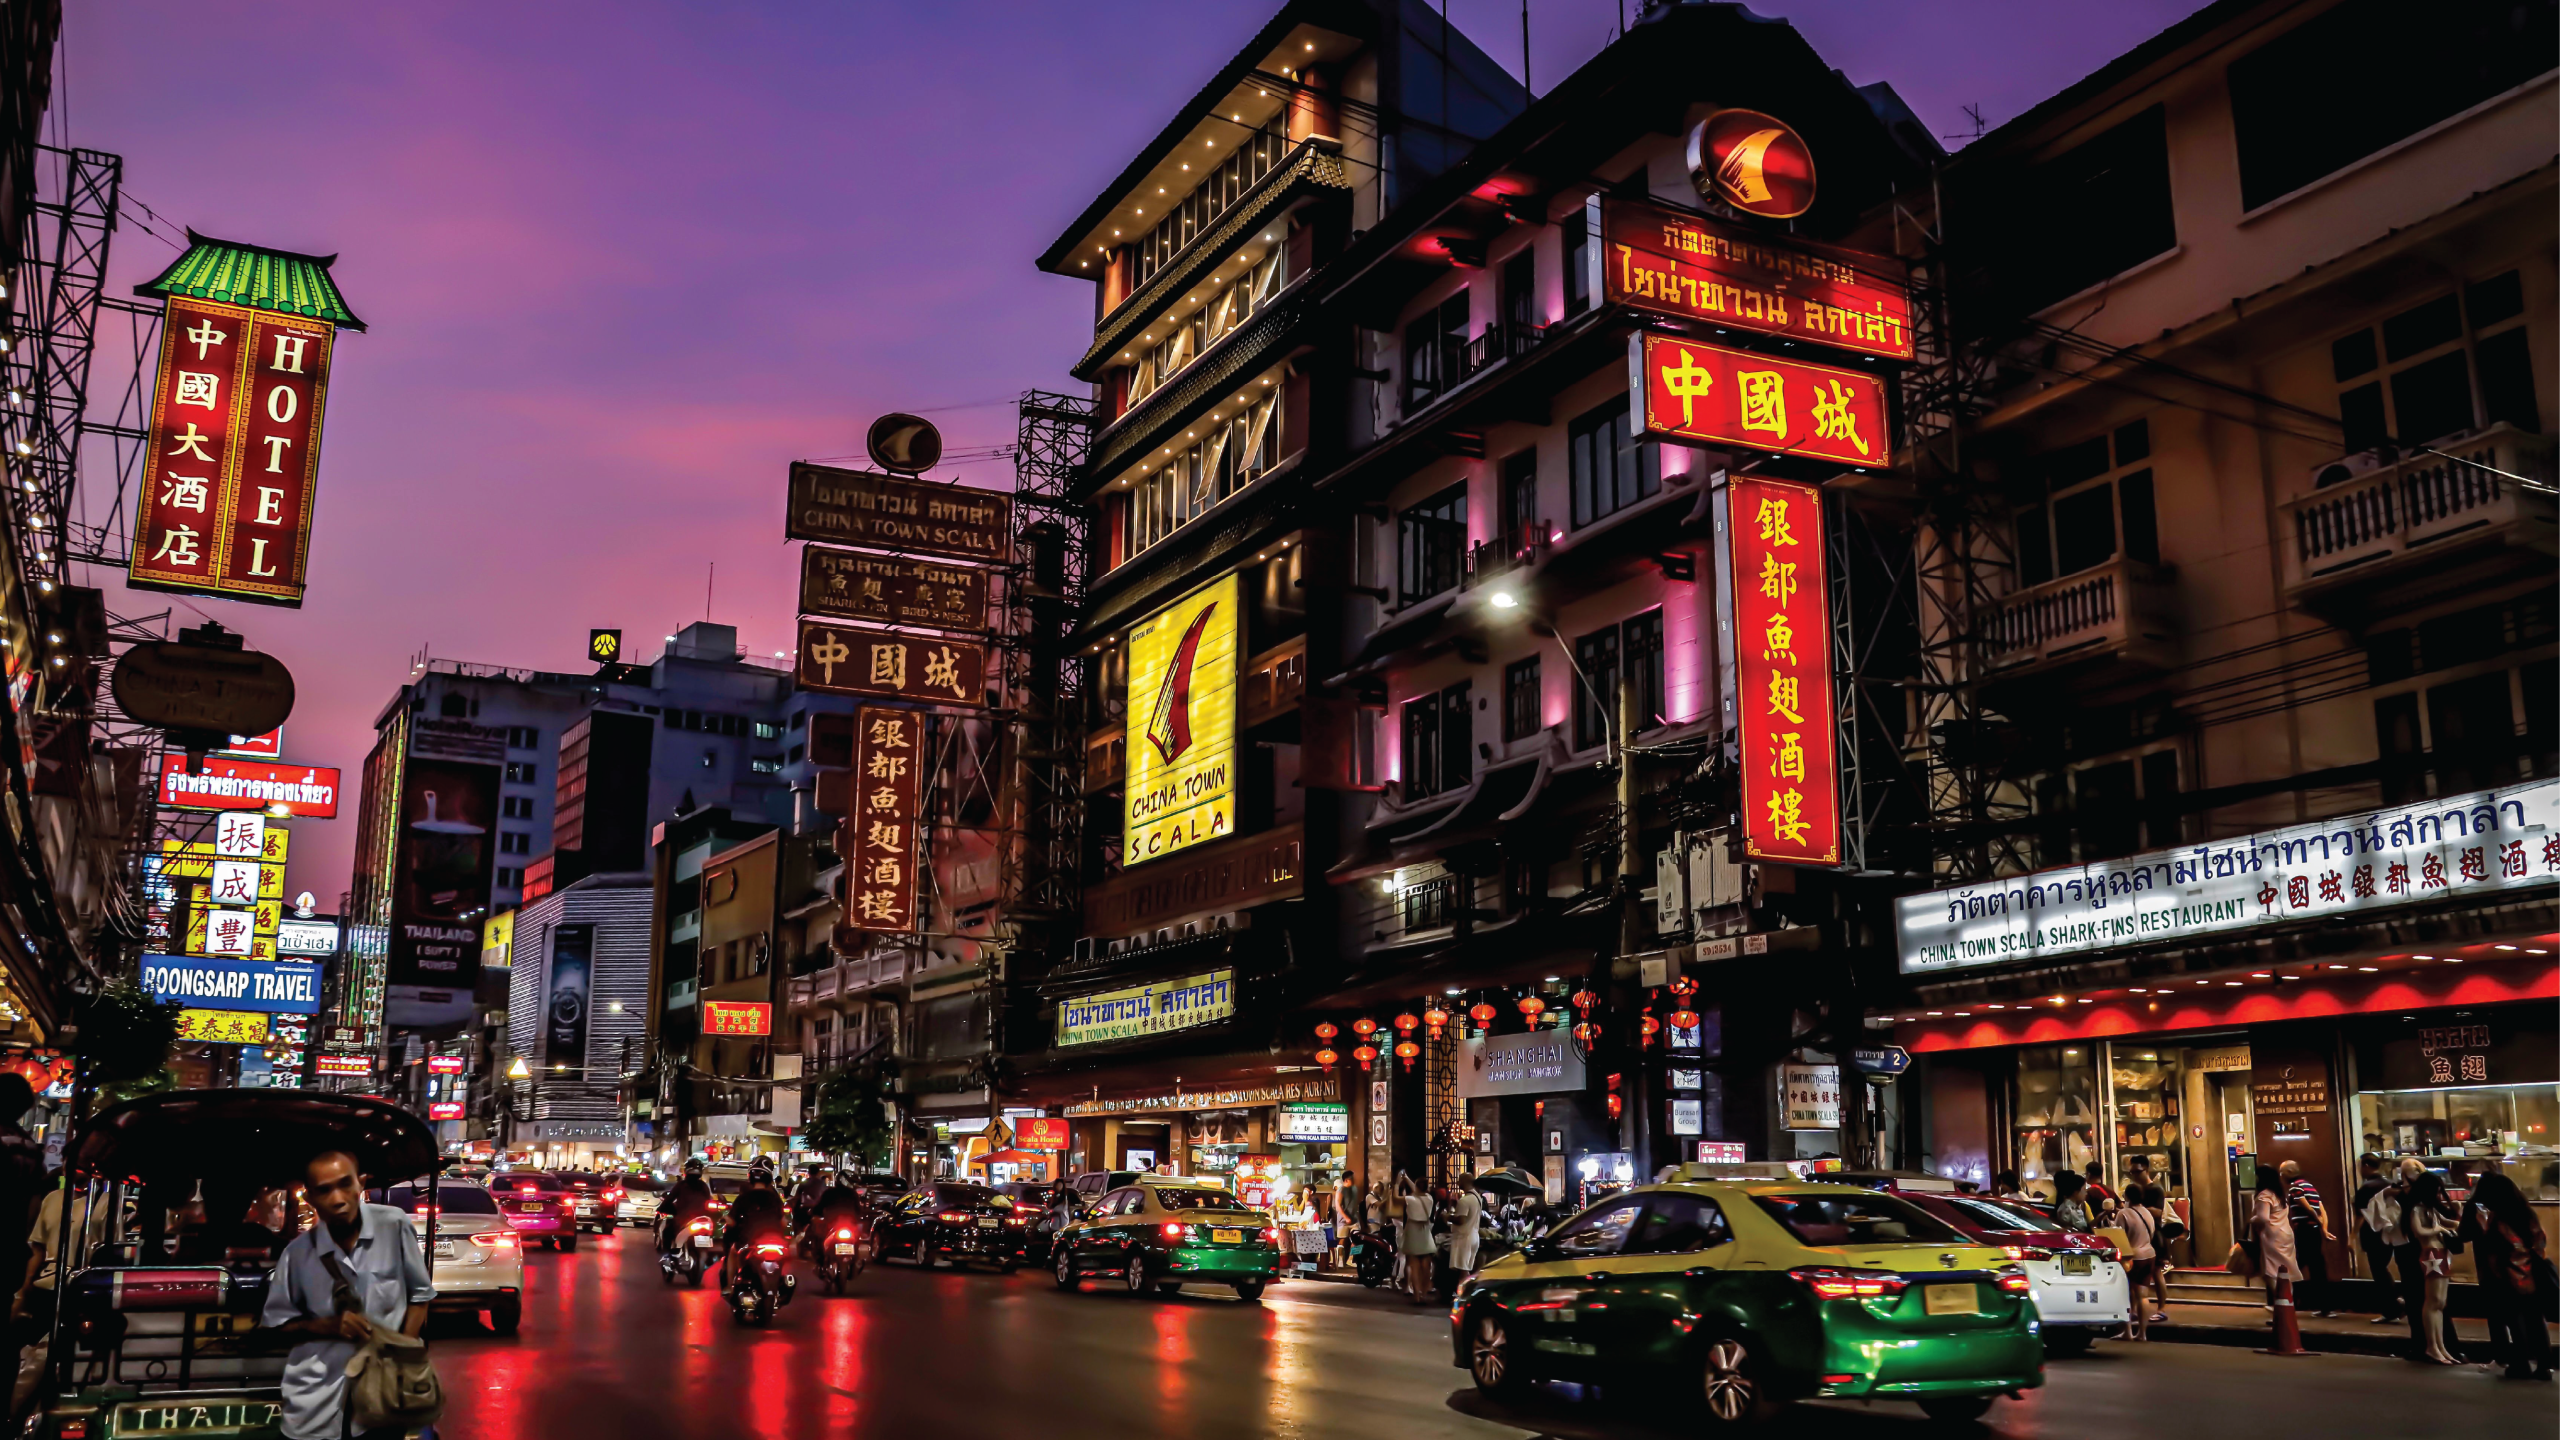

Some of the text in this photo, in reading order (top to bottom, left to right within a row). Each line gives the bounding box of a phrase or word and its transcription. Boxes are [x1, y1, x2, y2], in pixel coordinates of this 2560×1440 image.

[1616, 244, 1903, 346] ไชน่าทาวน์ สกาล่า
[1661, 347, 1870, 456] 中國城
[151, 319, 228, 566] 中國大酒店
[247, 334, 309, 577] HOTEL
[803, 509, 997, 551] CHINA TOWN SCALA
[942, 611, 971, 623] NEST
[811, 631, 965, 699] 中國城
[1754, 498, 1812, 848] 銀都魚翅酒樓
[1132, 763, 1226, 820] CHINA TOWN
[857, 717, 910, 923] 銀都魚翅酒樓
[1130, 810, 1225, 862] SCALA
[404, 924, 477, 943] THAILAND
[1920, 898, 2246, 965] CHINA TOWN SCALA SHARK-FINS RESTAURANT
[253, 973, 316, 1002] TRAVEL
[418, 960, 457, 971] POWER
[1062, 973, 1229, 1028] ไชน่าทาวน์ สกาล่า
[1060, 1023, 1138, 1045] CHINA TOWN SCALA
[1488, 1043, 1562, 1068] SHANGHAI
[1893, 1053, 1901, 1066] 2
[2428, 1055, 2488, 1083] 魚翅
[1017, 1135, 1064, 1145] Scala Hostel
